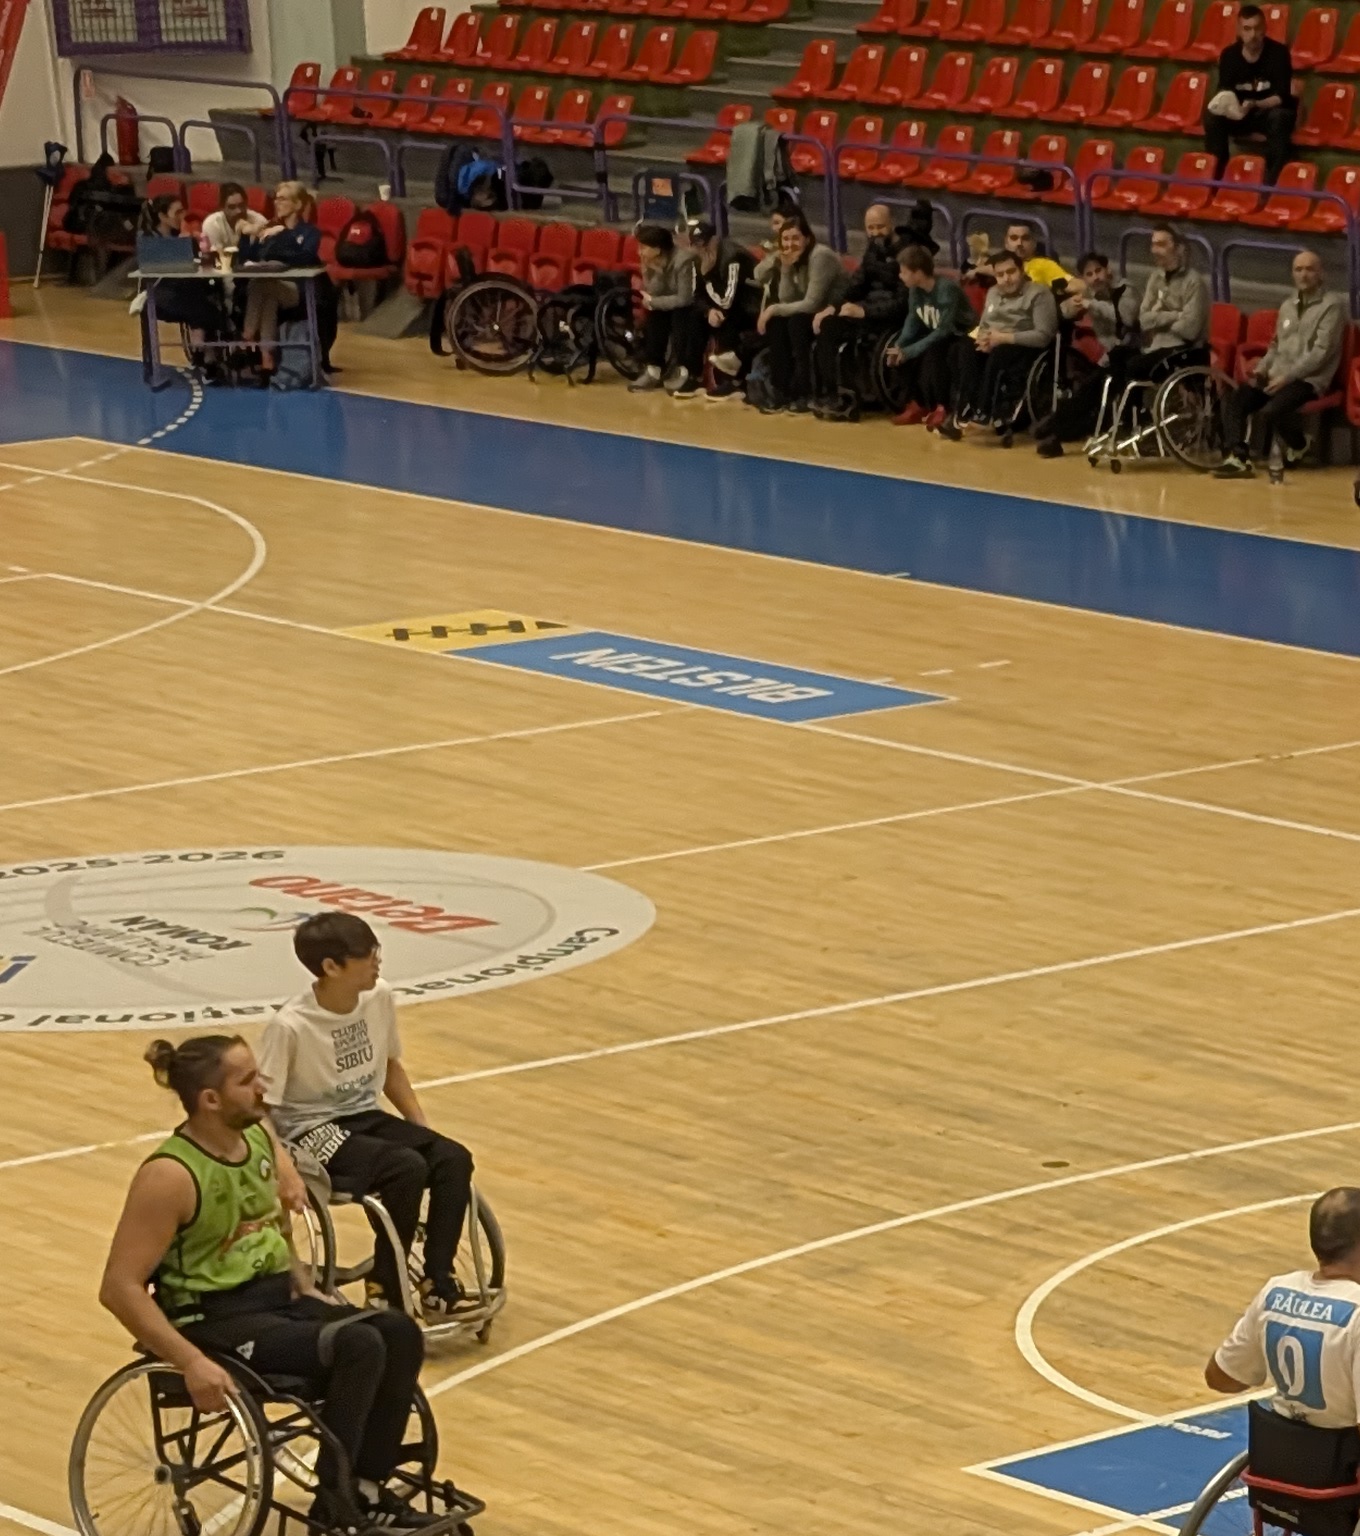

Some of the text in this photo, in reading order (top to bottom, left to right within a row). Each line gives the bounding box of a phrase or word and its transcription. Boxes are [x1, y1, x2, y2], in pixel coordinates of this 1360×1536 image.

[548, 648, 834, 704] BILSTEIN
[248, 875, 501, 935] Betano
[28, 926, 620, 1027] Campionat ațional
[336, 1044, 374, 1073] SIBIU
[1271, 1291, 1333, 1321] RĂULEA
[1276, 1335, 1305, 1396] 0
